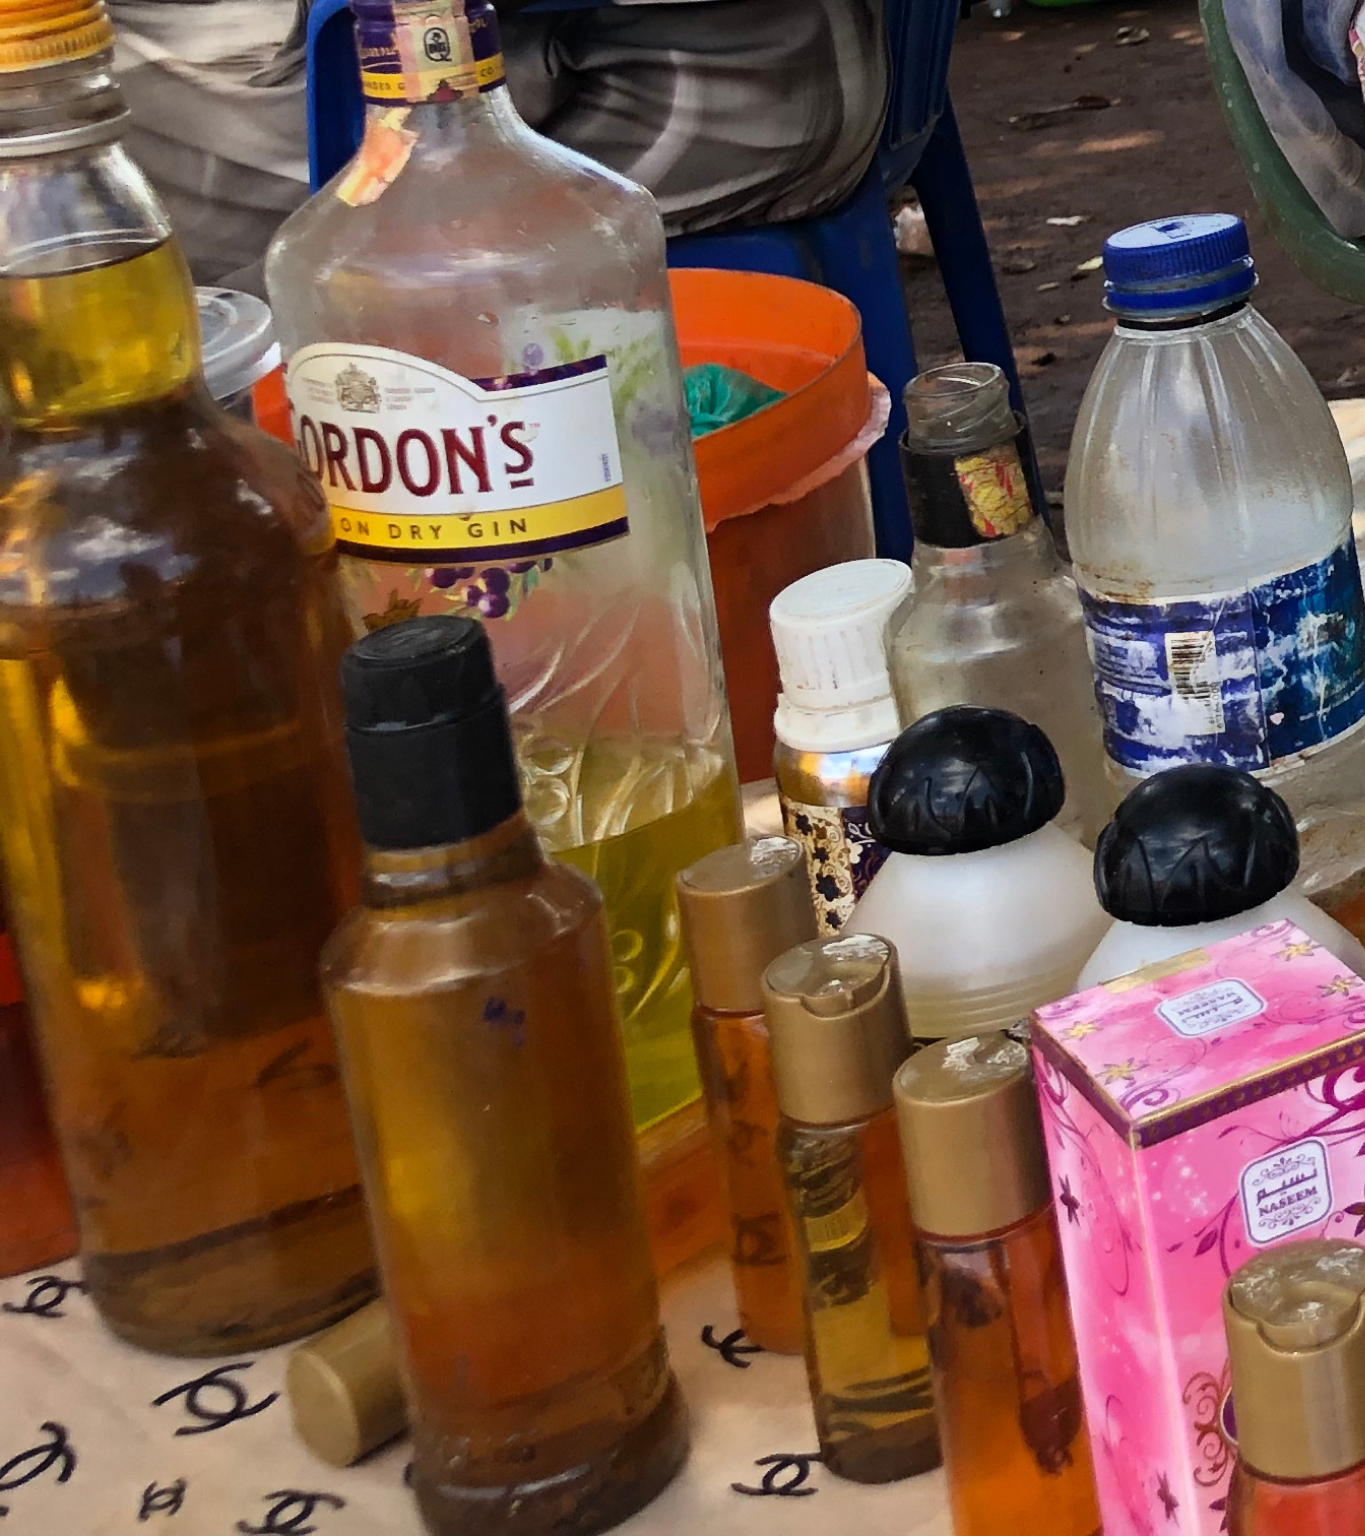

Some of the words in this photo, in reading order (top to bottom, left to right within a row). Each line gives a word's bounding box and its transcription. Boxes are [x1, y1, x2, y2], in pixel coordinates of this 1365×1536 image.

[297, 414, 534, 497] ORDON'S
[389, 523, 443, 540] DRY
[467, 518, 528, 539] GIN
[1258, 1185, 1318, 1218] NASEEM
